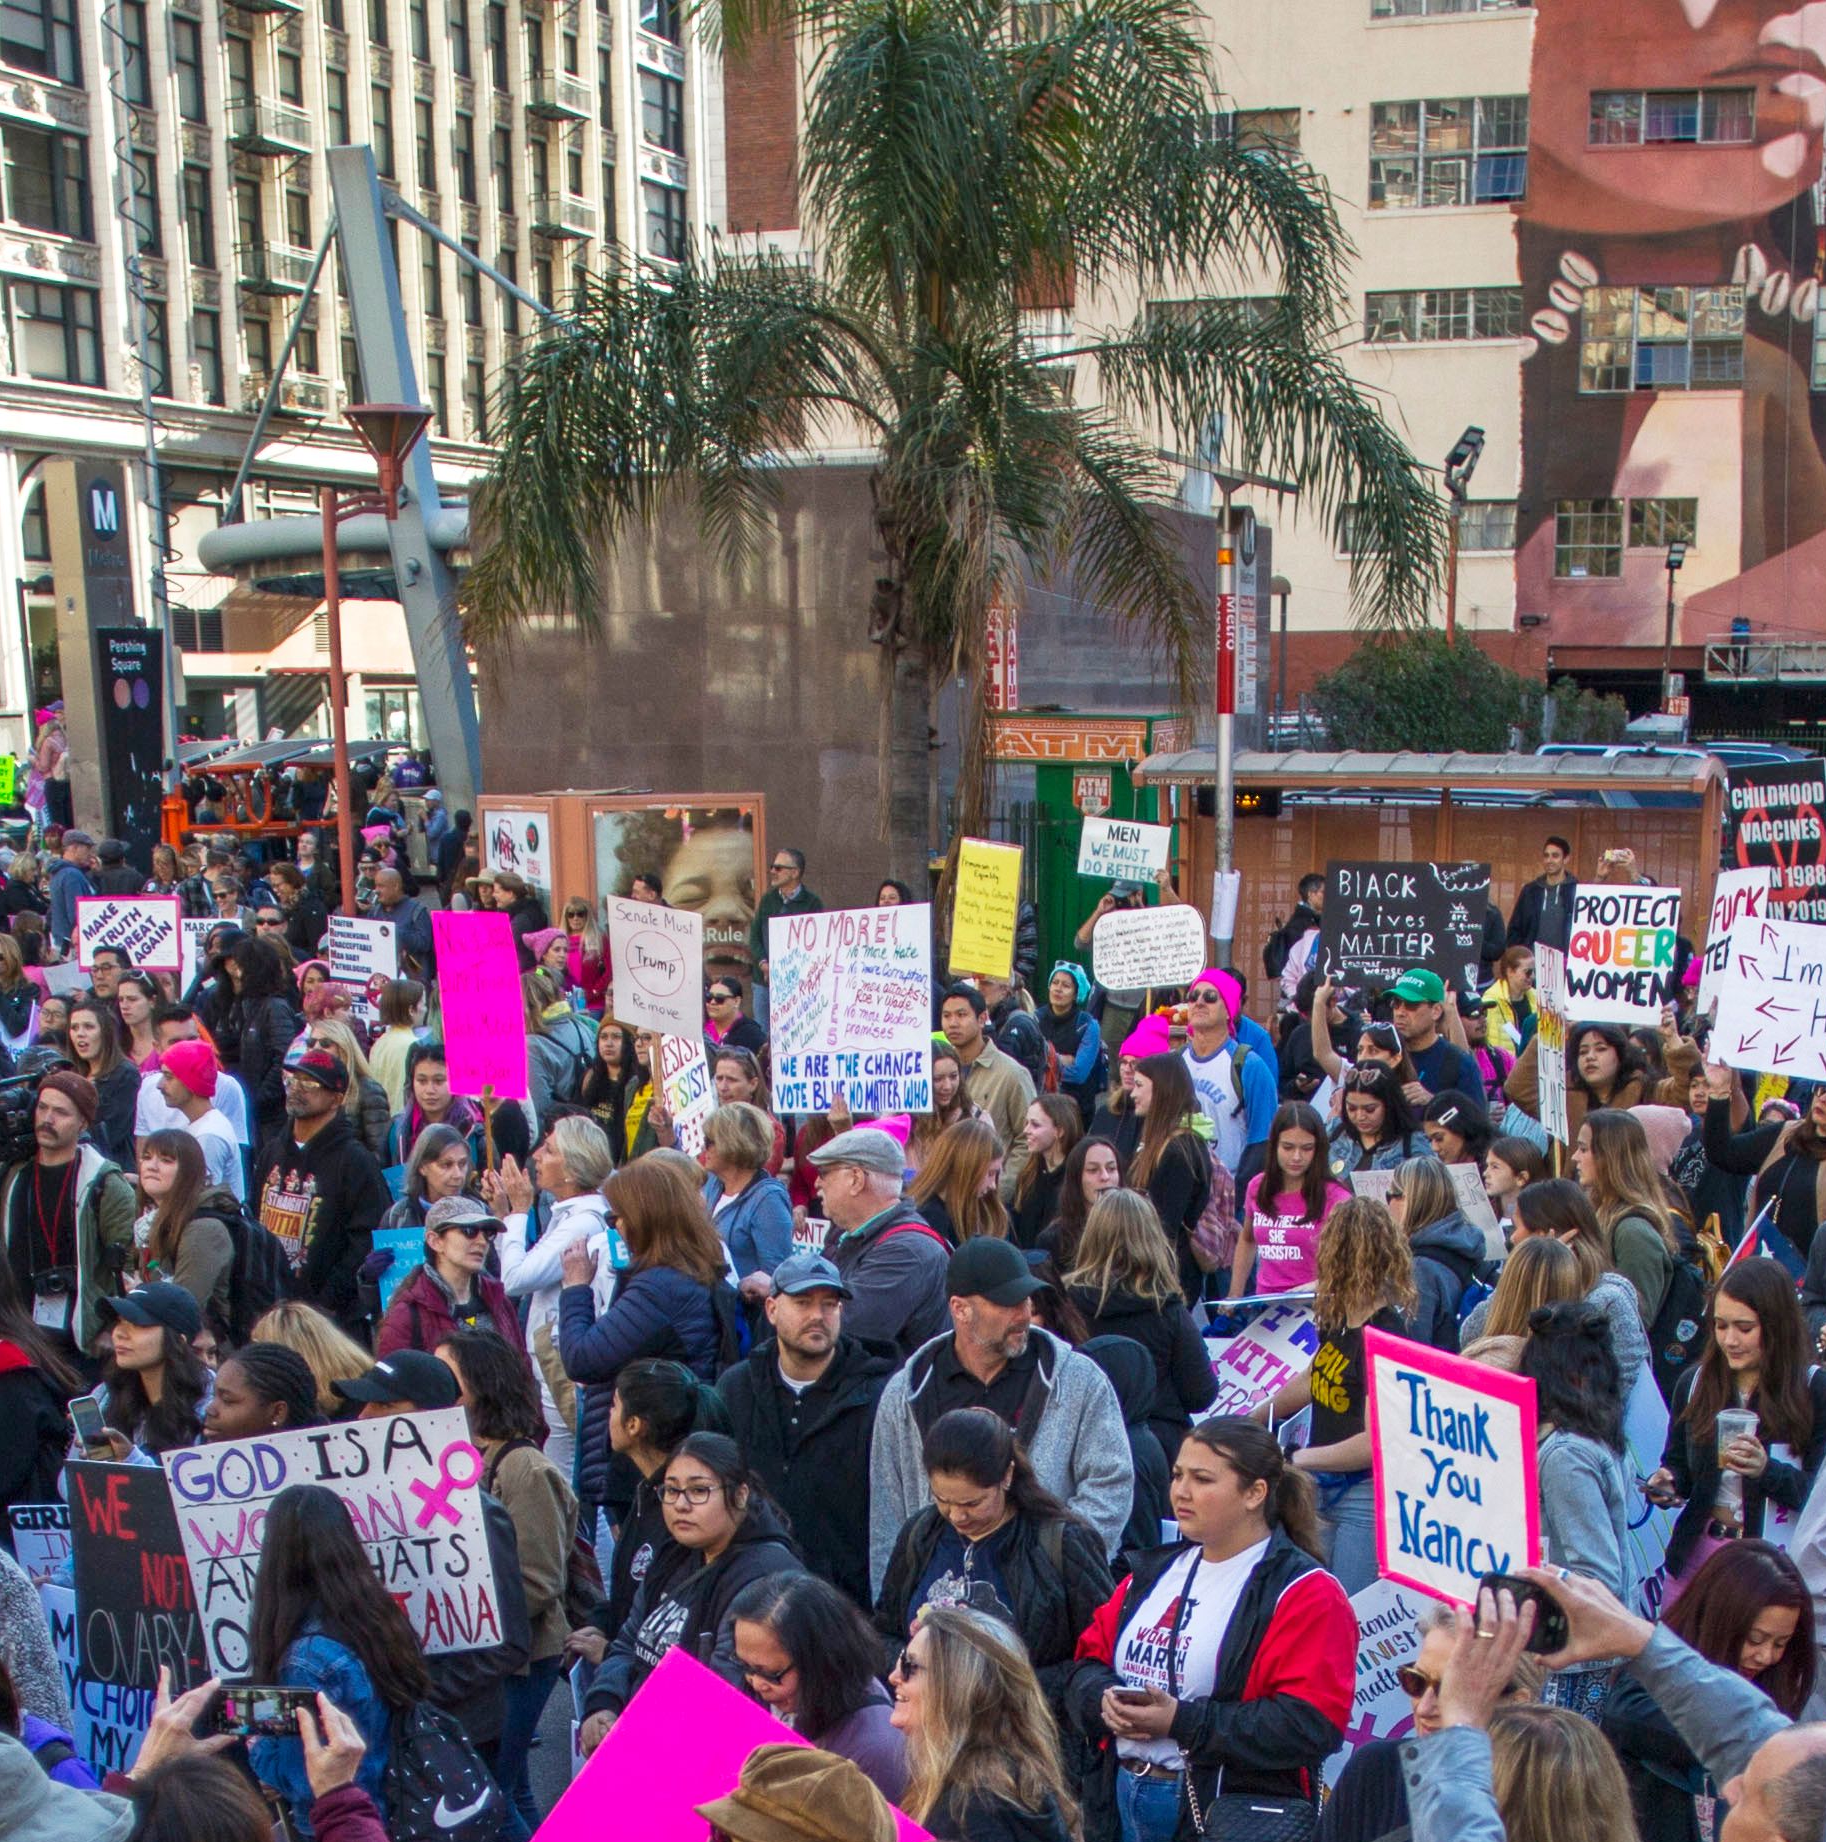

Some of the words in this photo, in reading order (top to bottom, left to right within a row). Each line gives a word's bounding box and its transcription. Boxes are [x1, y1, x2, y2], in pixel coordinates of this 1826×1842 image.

[93, 489, 115, 531] M
[109, 639, 146, 655] Pershing
[112, 658, 141, 672] Square
[995, 732, 1141, 760] ATM
[1077, 778, 1110, 798] ATM
[1146, 776, 1196, 786] OUTFRONT
[1731, 781, 1825, 810] CHILDHOOD
[1106, 825, 1141, 844] MEN
[1740, 817, 1821, 845] VACCINES
[1091, 842, 1111, 858] WE
[1113, 845, 1150, 863] MUST
[1083, 860, 1104, 876] DO
[1106, 863, 1158, 882] BETTER
[1784, 864, 1826, 888] 1988
[81, 902, 120, 942] MAKE
[97, 906, 143, 946] TRUTH
[614, 901, 659, 930] Senate
[663, 914, 695, 937] Must
[1573, 894, 1681, 927] PROTECT
[1712, 884, 1765, 934] FUCK
[133, 920, 173, 964] AGAIN
[787, 915, 818, 952] NO
[825, 909, 899, 949] MORE!
[1339, 932, 1436, 956] MATTER
[1569, 929, 1675, 968] QUEER
[633, 942, 677, 979] Trump
[1773, 945, 1824, 985] I'm
[1564, 968, 1674, 1008] WOMEN
[631, 993, 684, 1021] Remove
[661, 1035, 701, 1080] ESIST
[780, 1054, 798, 1077] WE
[805, 1053, 829, 1077] ARE
[834, 1052, 860, 1077] THE
[864, 1050, 923, 1077] CHANGE
[775, 1082, 807, 1110] VOTE
[849, 1082, 863, 1109] NO
[863, 1081, 901, 1110] MATTER
[902, 1081, 929, 1110] WHO
[1268, 1229, 1286, 1244] SHE
[1395, 1369, 1499, 1462] Thank
[171, 1446, 286, 1503] GOD
[315, 1427, 367, 1484] IS
[386, 1416, 434, 1468] A
[1420, 1450, 1481, 1505] You
[77, 1471, 136, 1539] WE
[188, 1496, 407, 1558] WOAN
[1395, 1492, 1511, 1579] Nancy
[140, 1553, 191, 1608] NOT
[1135, 1625, 1193, 1649] WOMN'S
